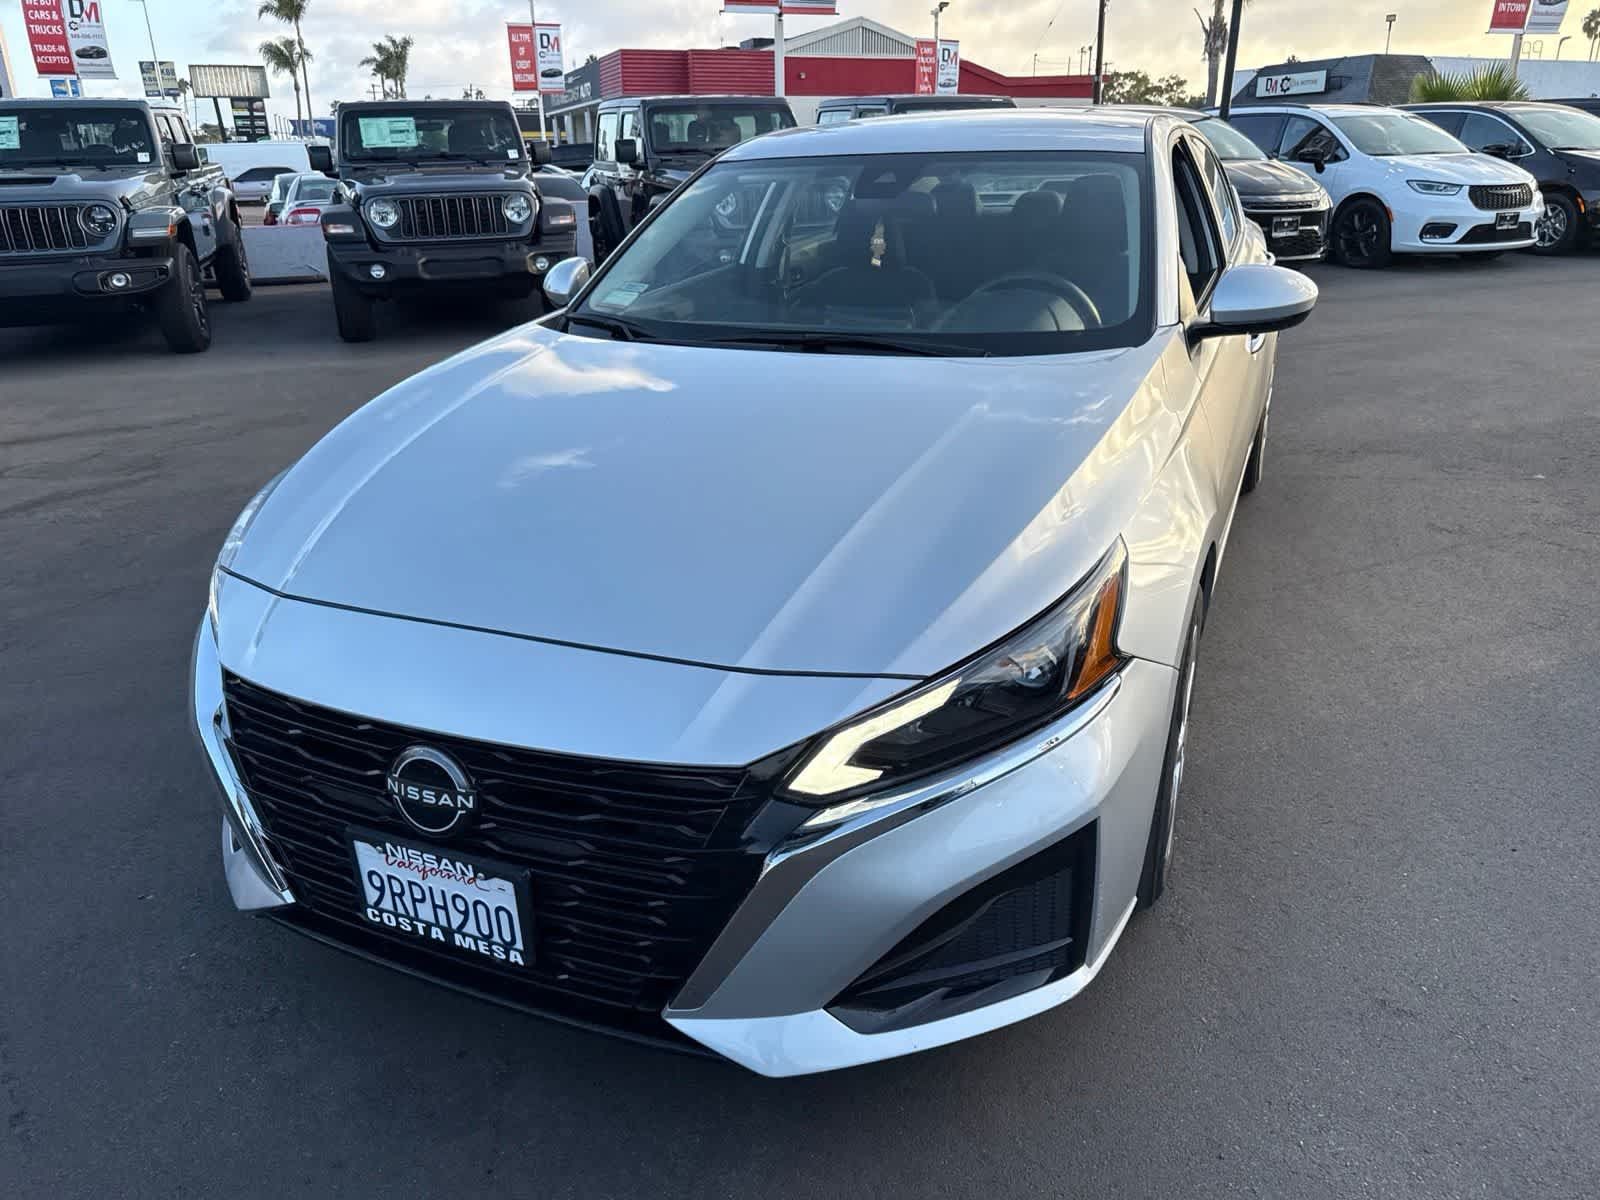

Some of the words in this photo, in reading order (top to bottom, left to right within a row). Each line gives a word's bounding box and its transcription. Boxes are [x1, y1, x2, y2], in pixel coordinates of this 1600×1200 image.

[1498, 3, 1506, 12] IN
[1507, 3, 1526, 12] TOWN
[28, 10, 50, 20] CARS
[52, 11, 58, 20] &
[29, 25, 63, 35] TRUCKS
[34, 44, 66, 53] TRADE-IN
[36, 56, 70, 64] ACCEPTED
[387, 778, 474, 809] NISSAN
[385, 842, 474, 878] NISSAN
[367, 869, 517, 947] 9RPH900
[366, 908, 446, 942] COSTA
[454, 933, 525, 967] MESA
